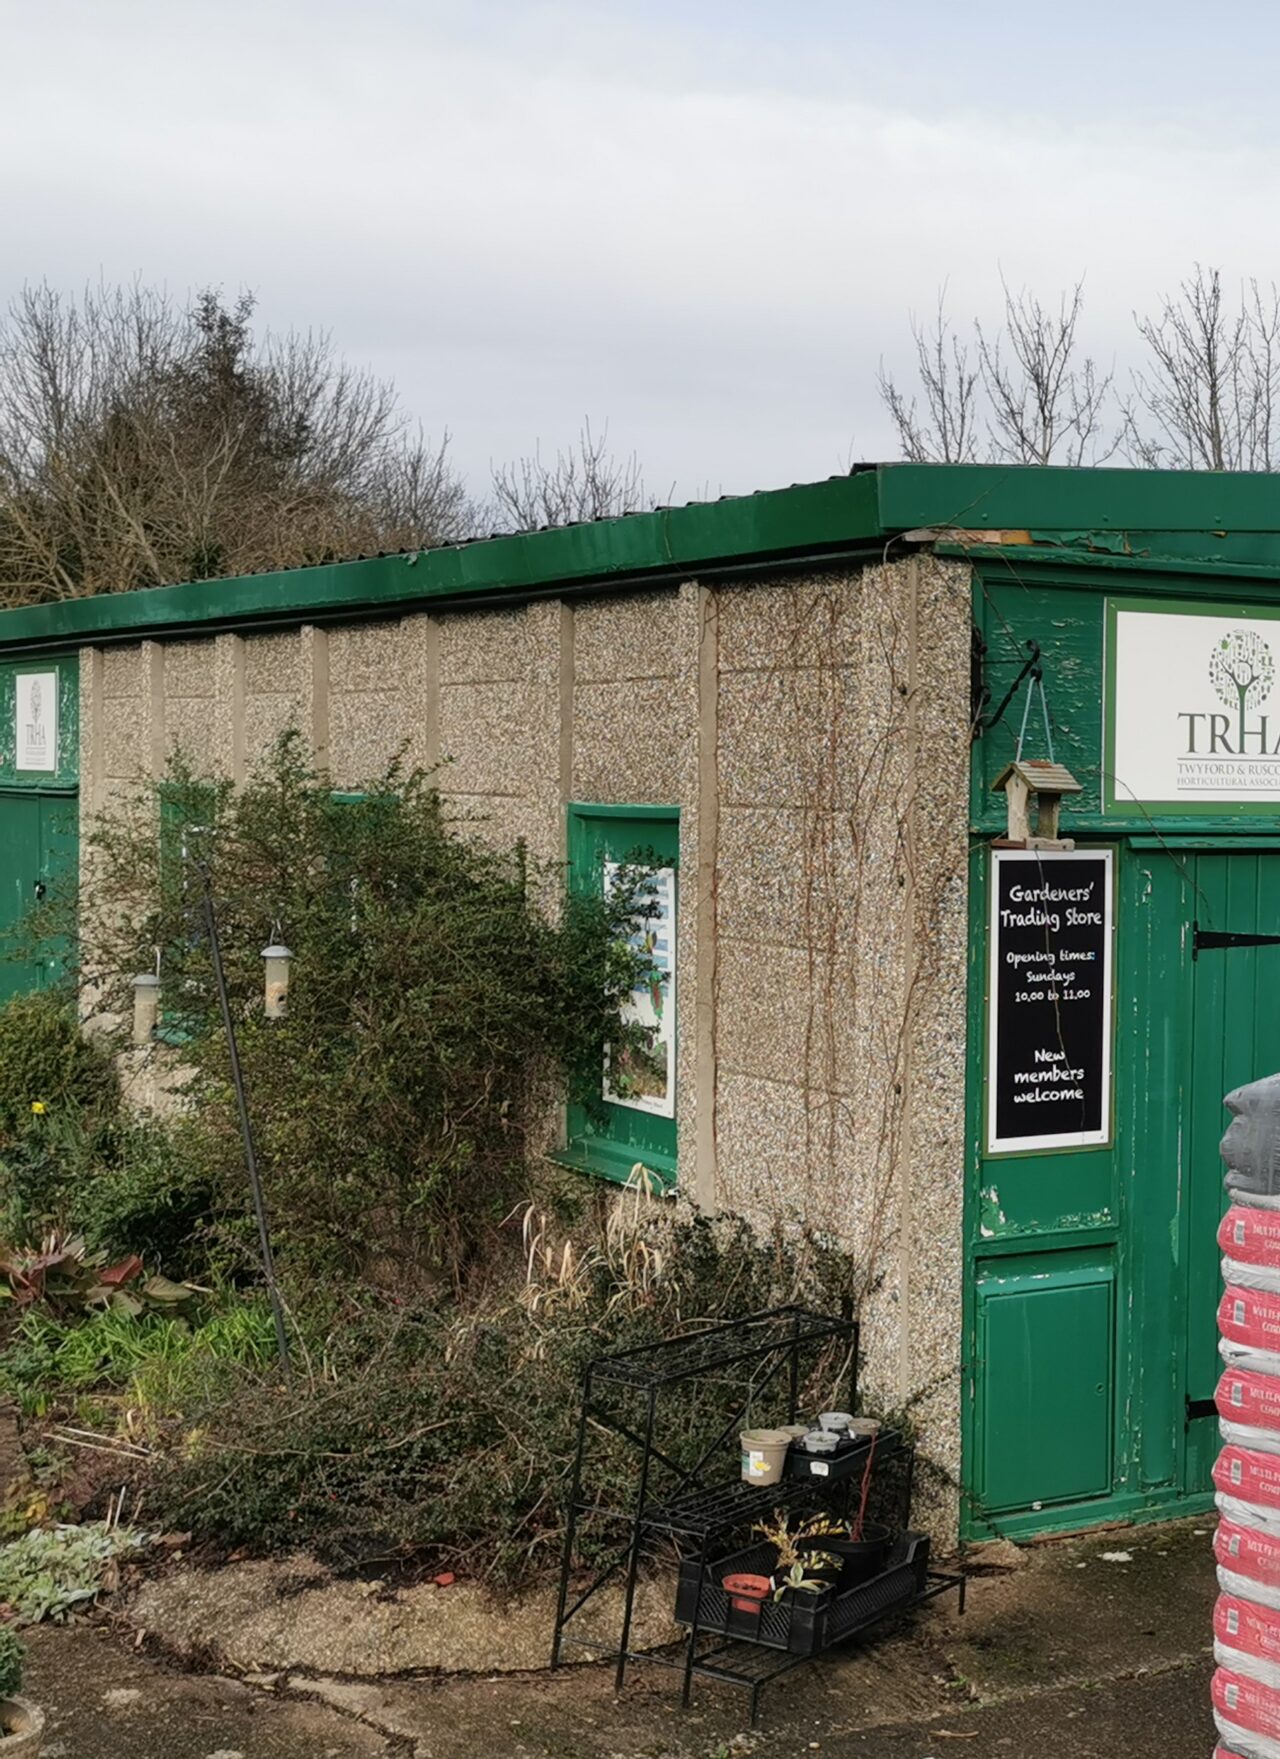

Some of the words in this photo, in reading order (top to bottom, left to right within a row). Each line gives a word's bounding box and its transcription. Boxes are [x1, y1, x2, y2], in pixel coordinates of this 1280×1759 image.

[1177, 763, 1235, 775] TWYFORD
[1236, 765, 1246, 775] &
[1177, 777, 1247, 787] HORTICULTURAL
[1009, 881, 1094, 902] Gardeners'
[1001, 906, 1060, 932] Trading
[1065, 907, 1102, 926] Store
[1006, 951, 1056, 969] Opening
[1059, 949, 1095, 961] times:
[1026, 969, 1075, 987] Sundays
[1015, 991, 1044, 1002] 10.00
[1047, 989, 1059, 1000] to
[1063, 989, 1091, 1000] 11.00
[1034, 1048, 1066, 1063] New
[1014, 1064, 1084, 1083] members
[1013, 1087, 1084, 1103] welcome
